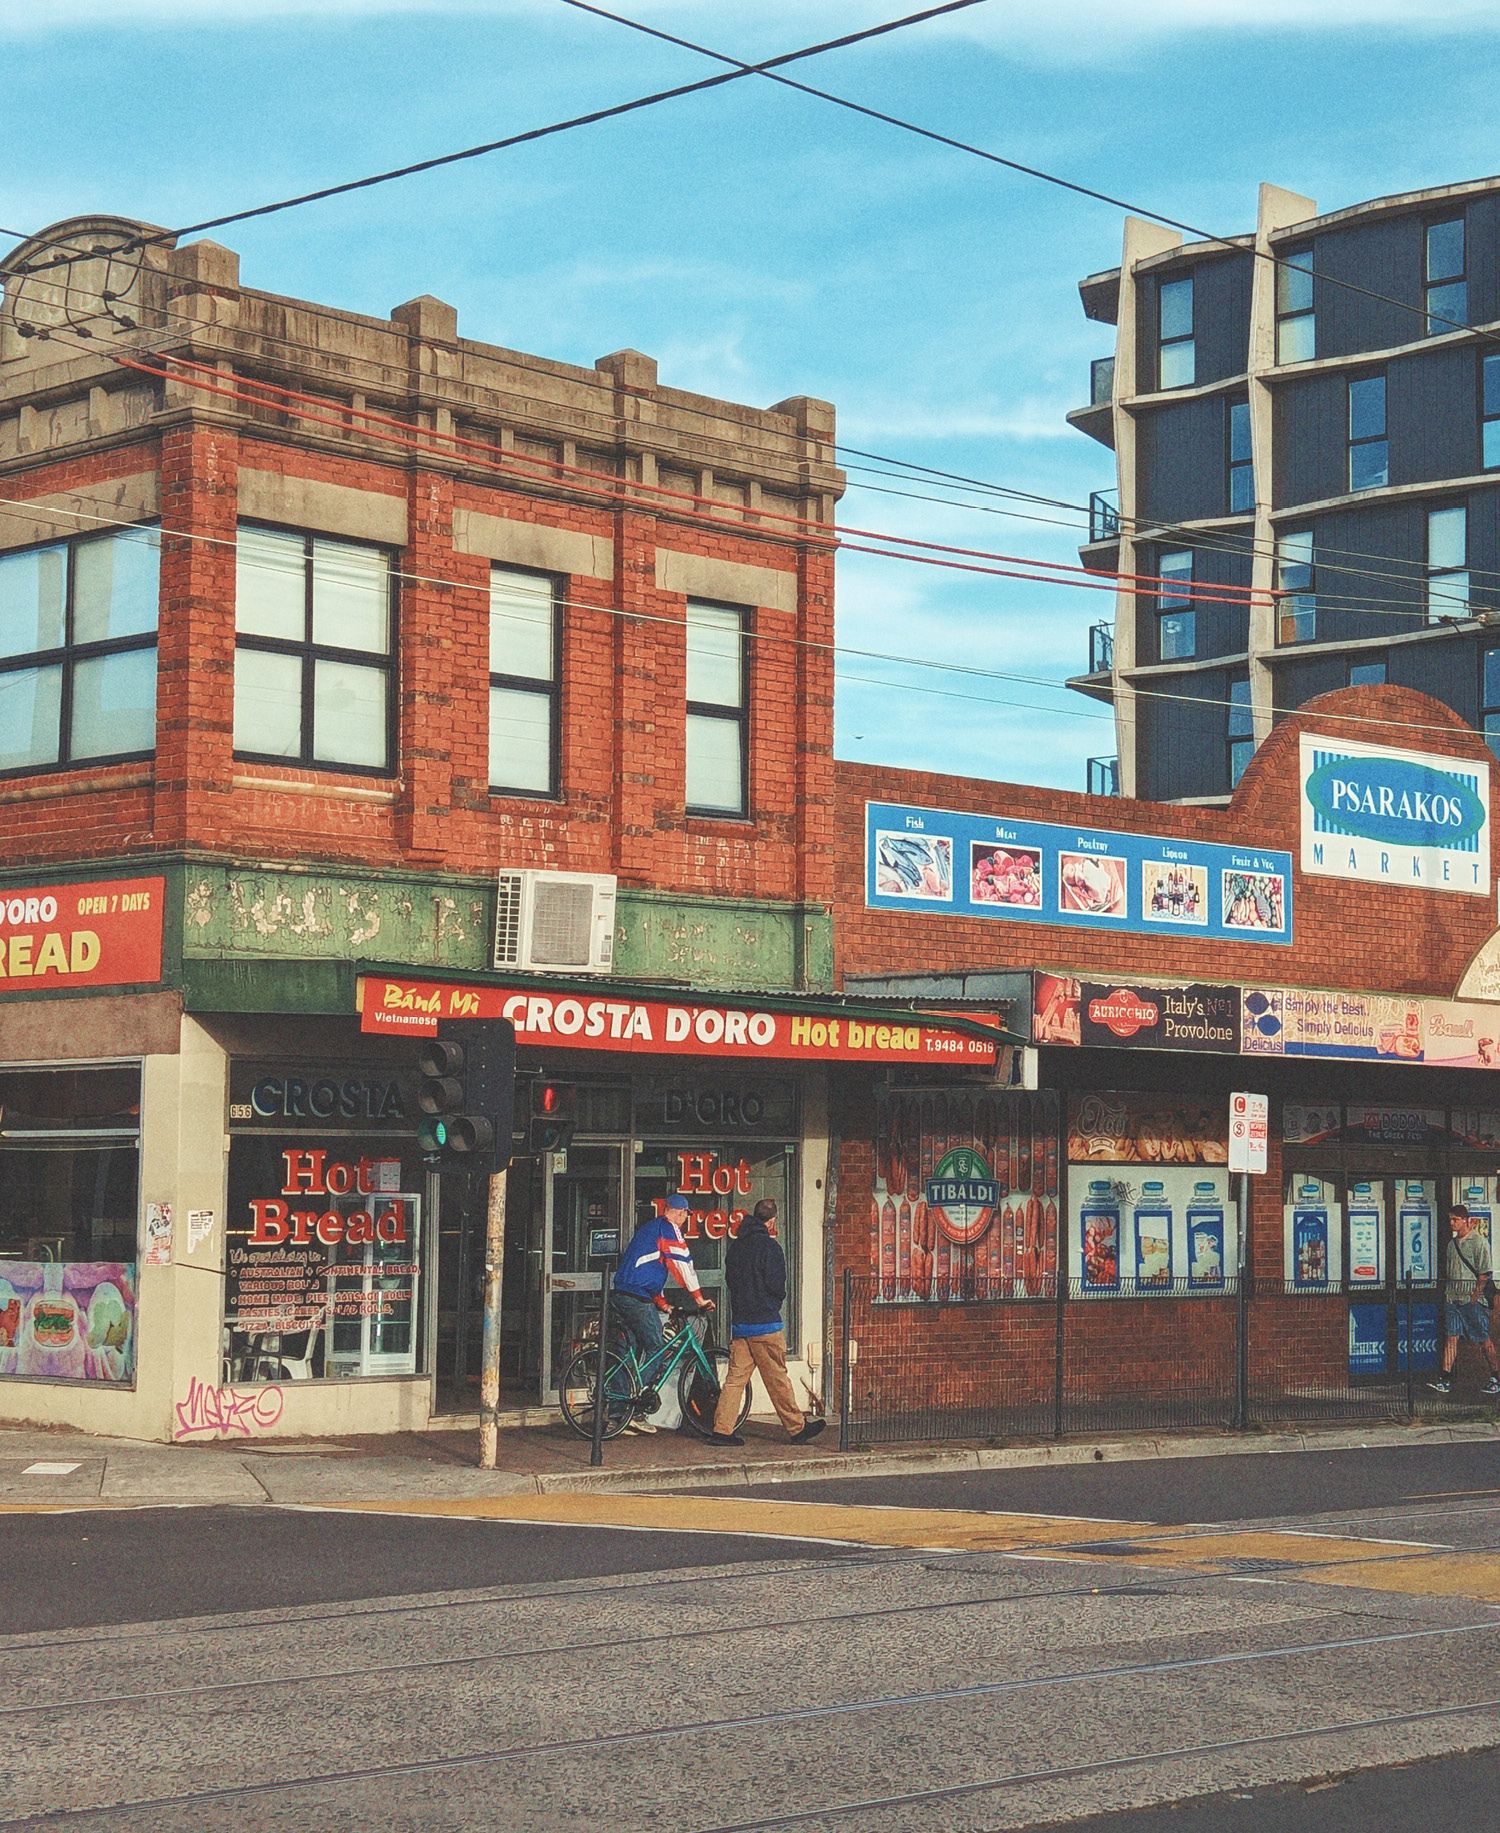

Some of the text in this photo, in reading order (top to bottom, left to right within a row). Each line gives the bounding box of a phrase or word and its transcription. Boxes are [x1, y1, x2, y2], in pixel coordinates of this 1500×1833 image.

[1331, 779, 1463, 827] PSARAKOS
[1313, 843, 1479, 885] MARKET
[0, 896, 58, 925] 'ORO
[78, 892, 150, 915] OPEN 7 DAYS
[384, 983, 442, 1013] Bánh
[1163, 995, 1204, 1017] Italy's
[1285, 998, 1319, 1015] Simply
[1323, 999, 1338, 1014] the
[375, 1012, 438, 1026] Vietnamese
[502, 996, 777, 1046] CROSTA D'ORO
[1165, 1019, 1233, 1040] Provolone
[1297, 1018, 1332, 1037] Simply
[791, 1016, 840, 1049] Hot
[251, 1076, 404, 1117] CROSTA
[231, 1104, 252, 1118] 656
[281, 1150, 376, 1195] Hot
[676, 1151, 752, 1196] Hot
[930, 1183, 993, 1202] TIBALDI
[247, 1199, 407, 1245] Bread
[240, 1266, 304, 1279] AUSTRALIAN
[239, 1280, 285, 1291] VARIOUS
[238, 1294, 269, 1305] HOME
